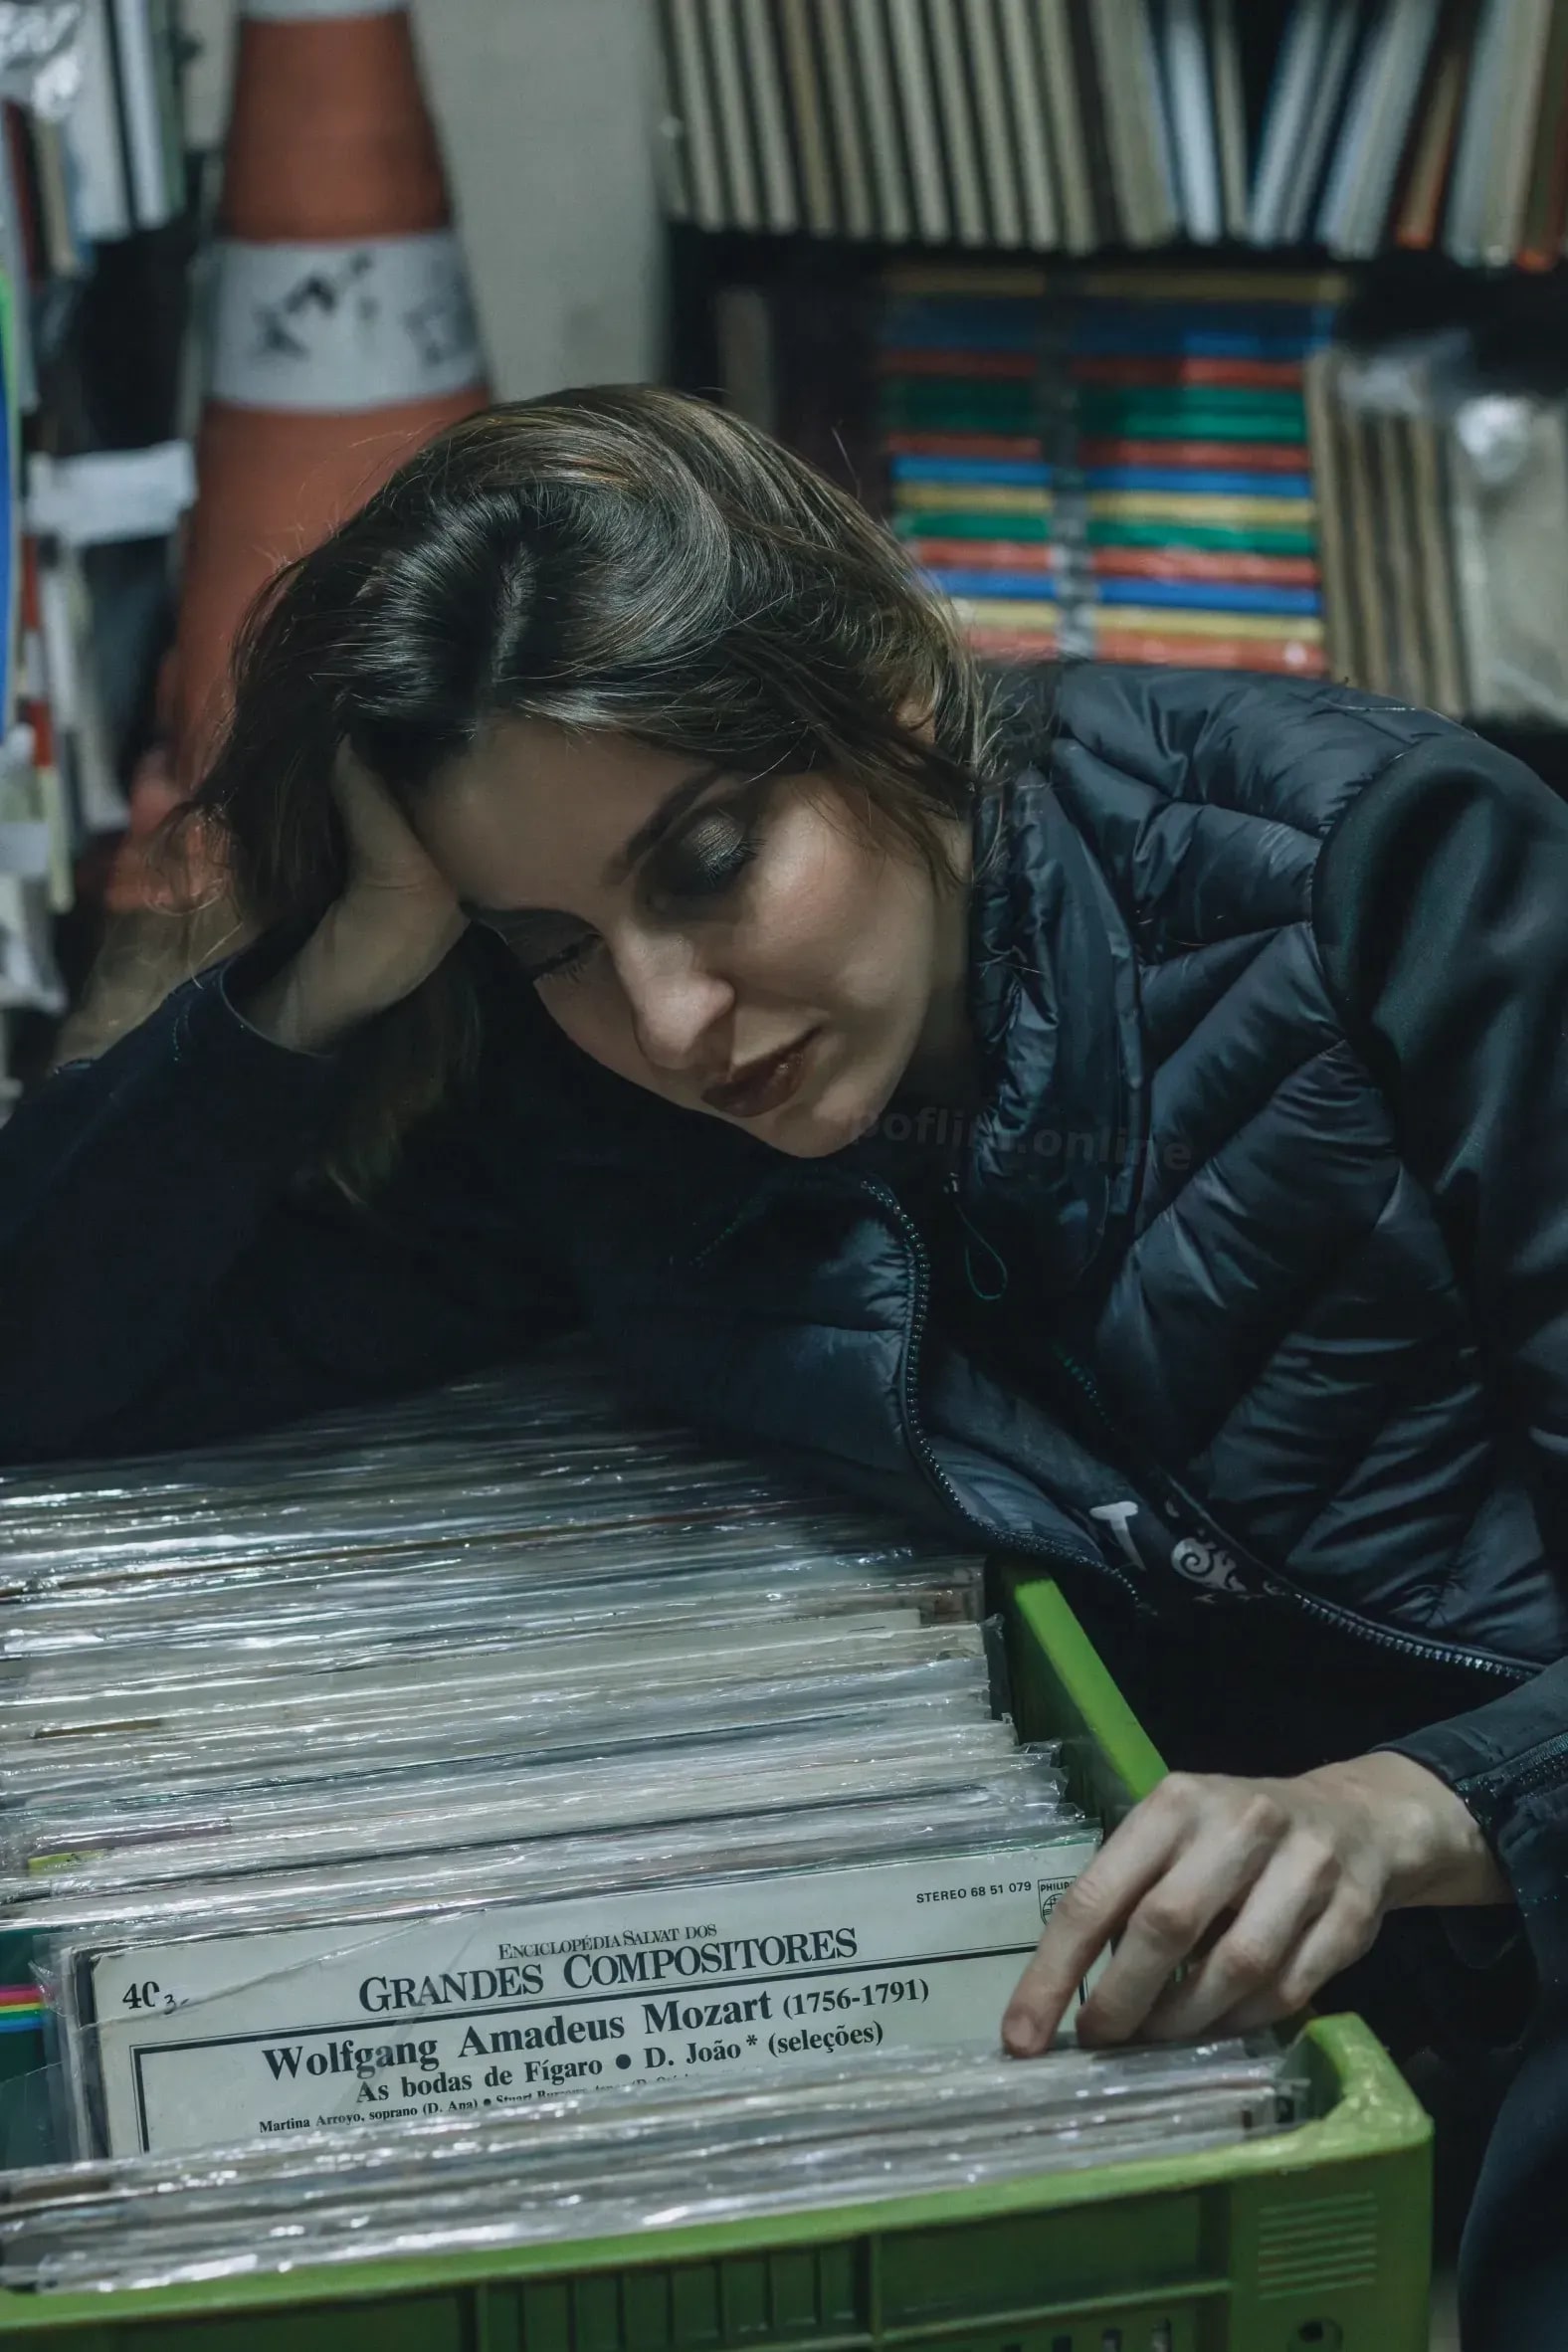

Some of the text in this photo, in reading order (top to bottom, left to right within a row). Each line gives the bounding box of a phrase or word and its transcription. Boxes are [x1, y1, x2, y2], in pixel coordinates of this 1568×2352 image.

[916, 1881, 1032, 1903] STEREO 68 51 079
[1040, 1881, 1074, 1892] PHILIP
[498, 1924, 717, 1960] ENCICLOPÉDIA SALVAT DOS
[359, 1927, 858, 2012] GRANDES COMPOSITORES
[262, 1978, 929, 2080] Wolfgang Amadeus Mozart (1756-1791)
[356, 2081, 389, 2103] As
[402, 2071, 473, 2098] bodas
[485, 2066, 512, 2088] de
[525, 2058, 603, 2085] Fígaro
[644, 2047, 675, 2069] D.
[768, 2021, 883, 2058] (seleções)
[259, 2118, 310, 2133] Martina
[316, 2112, 365, 2127] Arroyo,
[369, 2106, 418, 2121] soprano
[423, 2101, 444, 2116] (D.
